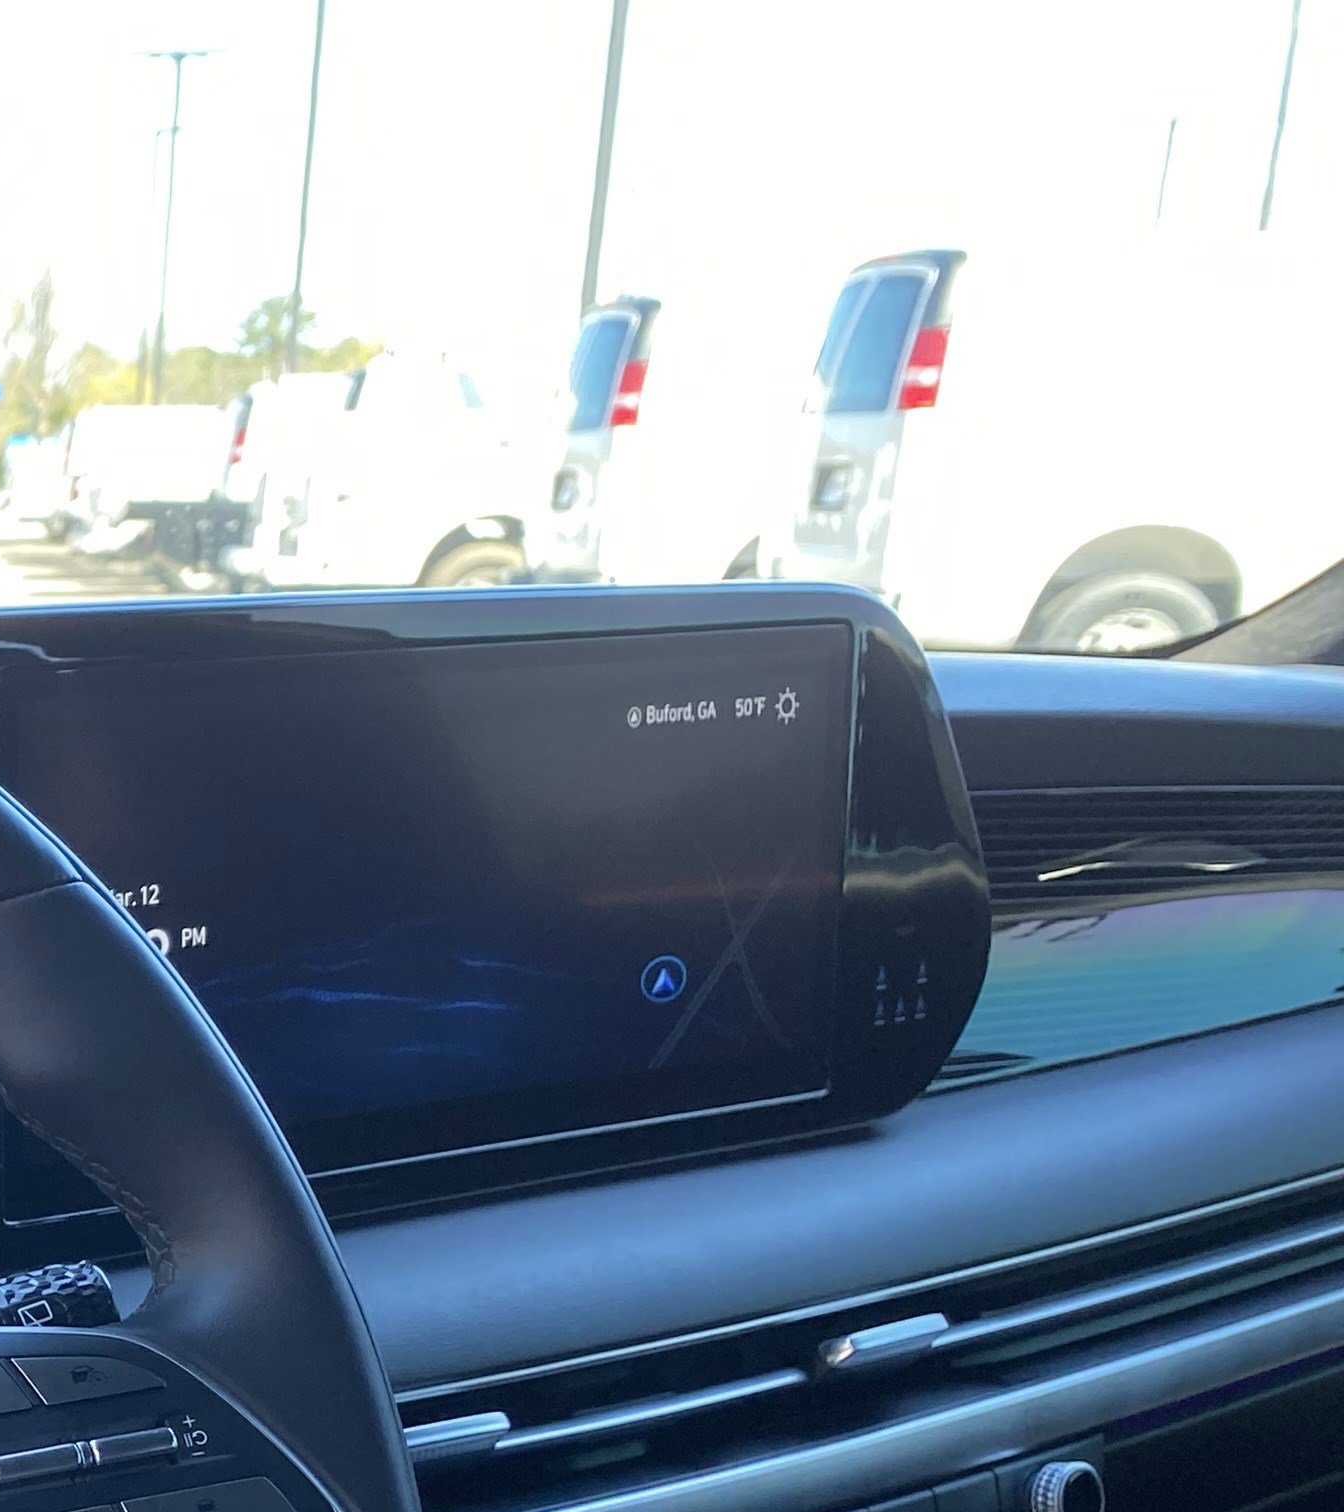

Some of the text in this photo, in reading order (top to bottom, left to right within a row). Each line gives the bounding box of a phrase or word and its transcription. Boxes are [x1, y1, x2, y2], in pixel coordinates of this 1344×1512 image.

[646, 700, 717, 725] Buford, GA
[140, 884, 160, 906] 12
[181, 926, 206, 948] PM
